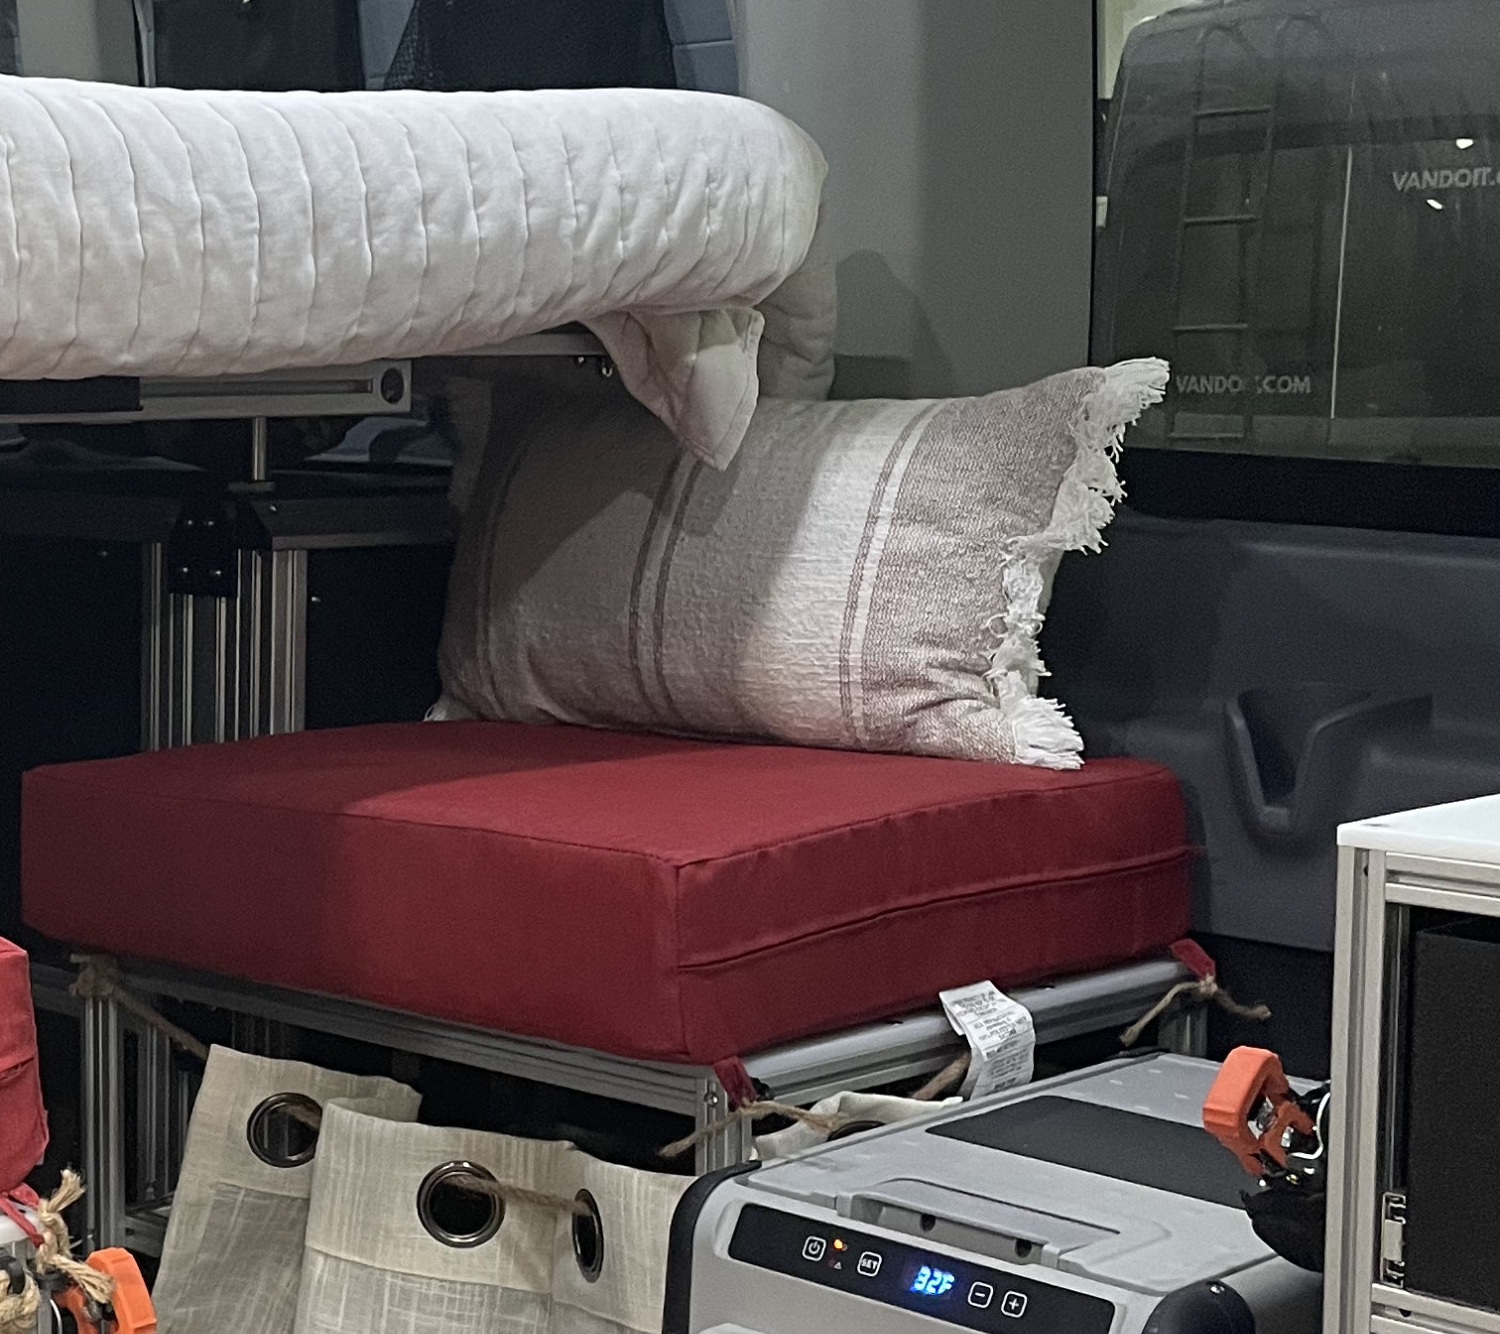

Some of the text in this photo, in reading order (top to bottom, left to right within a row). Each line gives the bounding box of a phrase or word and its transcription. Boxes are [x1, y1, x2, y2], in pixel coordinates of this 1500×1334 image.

[1392, 167, 1500, 192] VANDOIT.
[1175, 375, 1312, 395] VANDO.COM
[861, 1258, 878, 1270] SET
